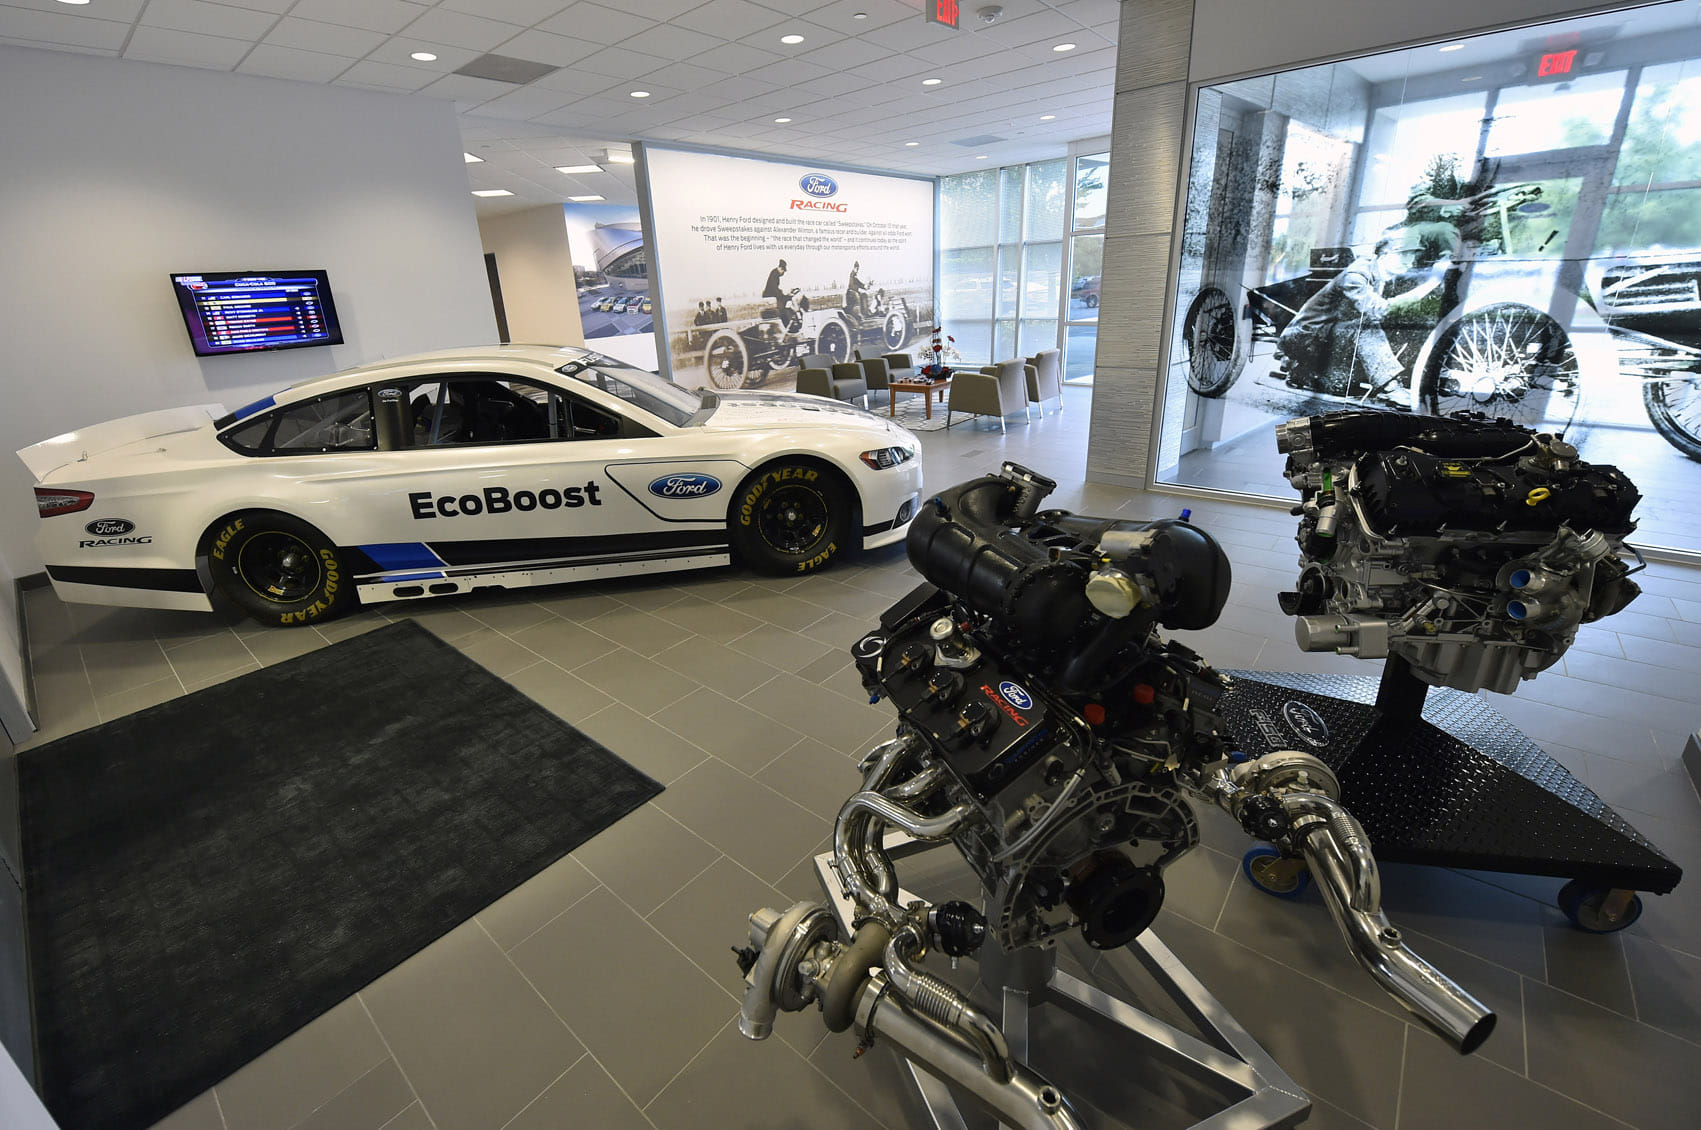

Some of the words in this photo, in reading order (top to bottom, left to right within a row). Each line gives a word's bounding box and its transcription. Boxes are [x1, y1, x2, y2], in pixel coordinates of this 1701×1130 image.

[1538, 50, 1577, 77] EXIT
[790, 199, 848, 212] RACING
[717, 225, 753, 233] Sweepstakes
[722, 216, 738, 224] Henry
[408, 481, 602, 519] EcoBoost
[663, 477, 708, 495] Ford
[740, 468, 818, 526] GOODYEAR
[79, 536, 152, 548] RACING
[213, 518, 245, 560] EAGLE
[797, 542, 837, 572] EAGLE
[280, 549, 340, 624] GOODYEAR
[979, 684, 1029, 727] RACING
